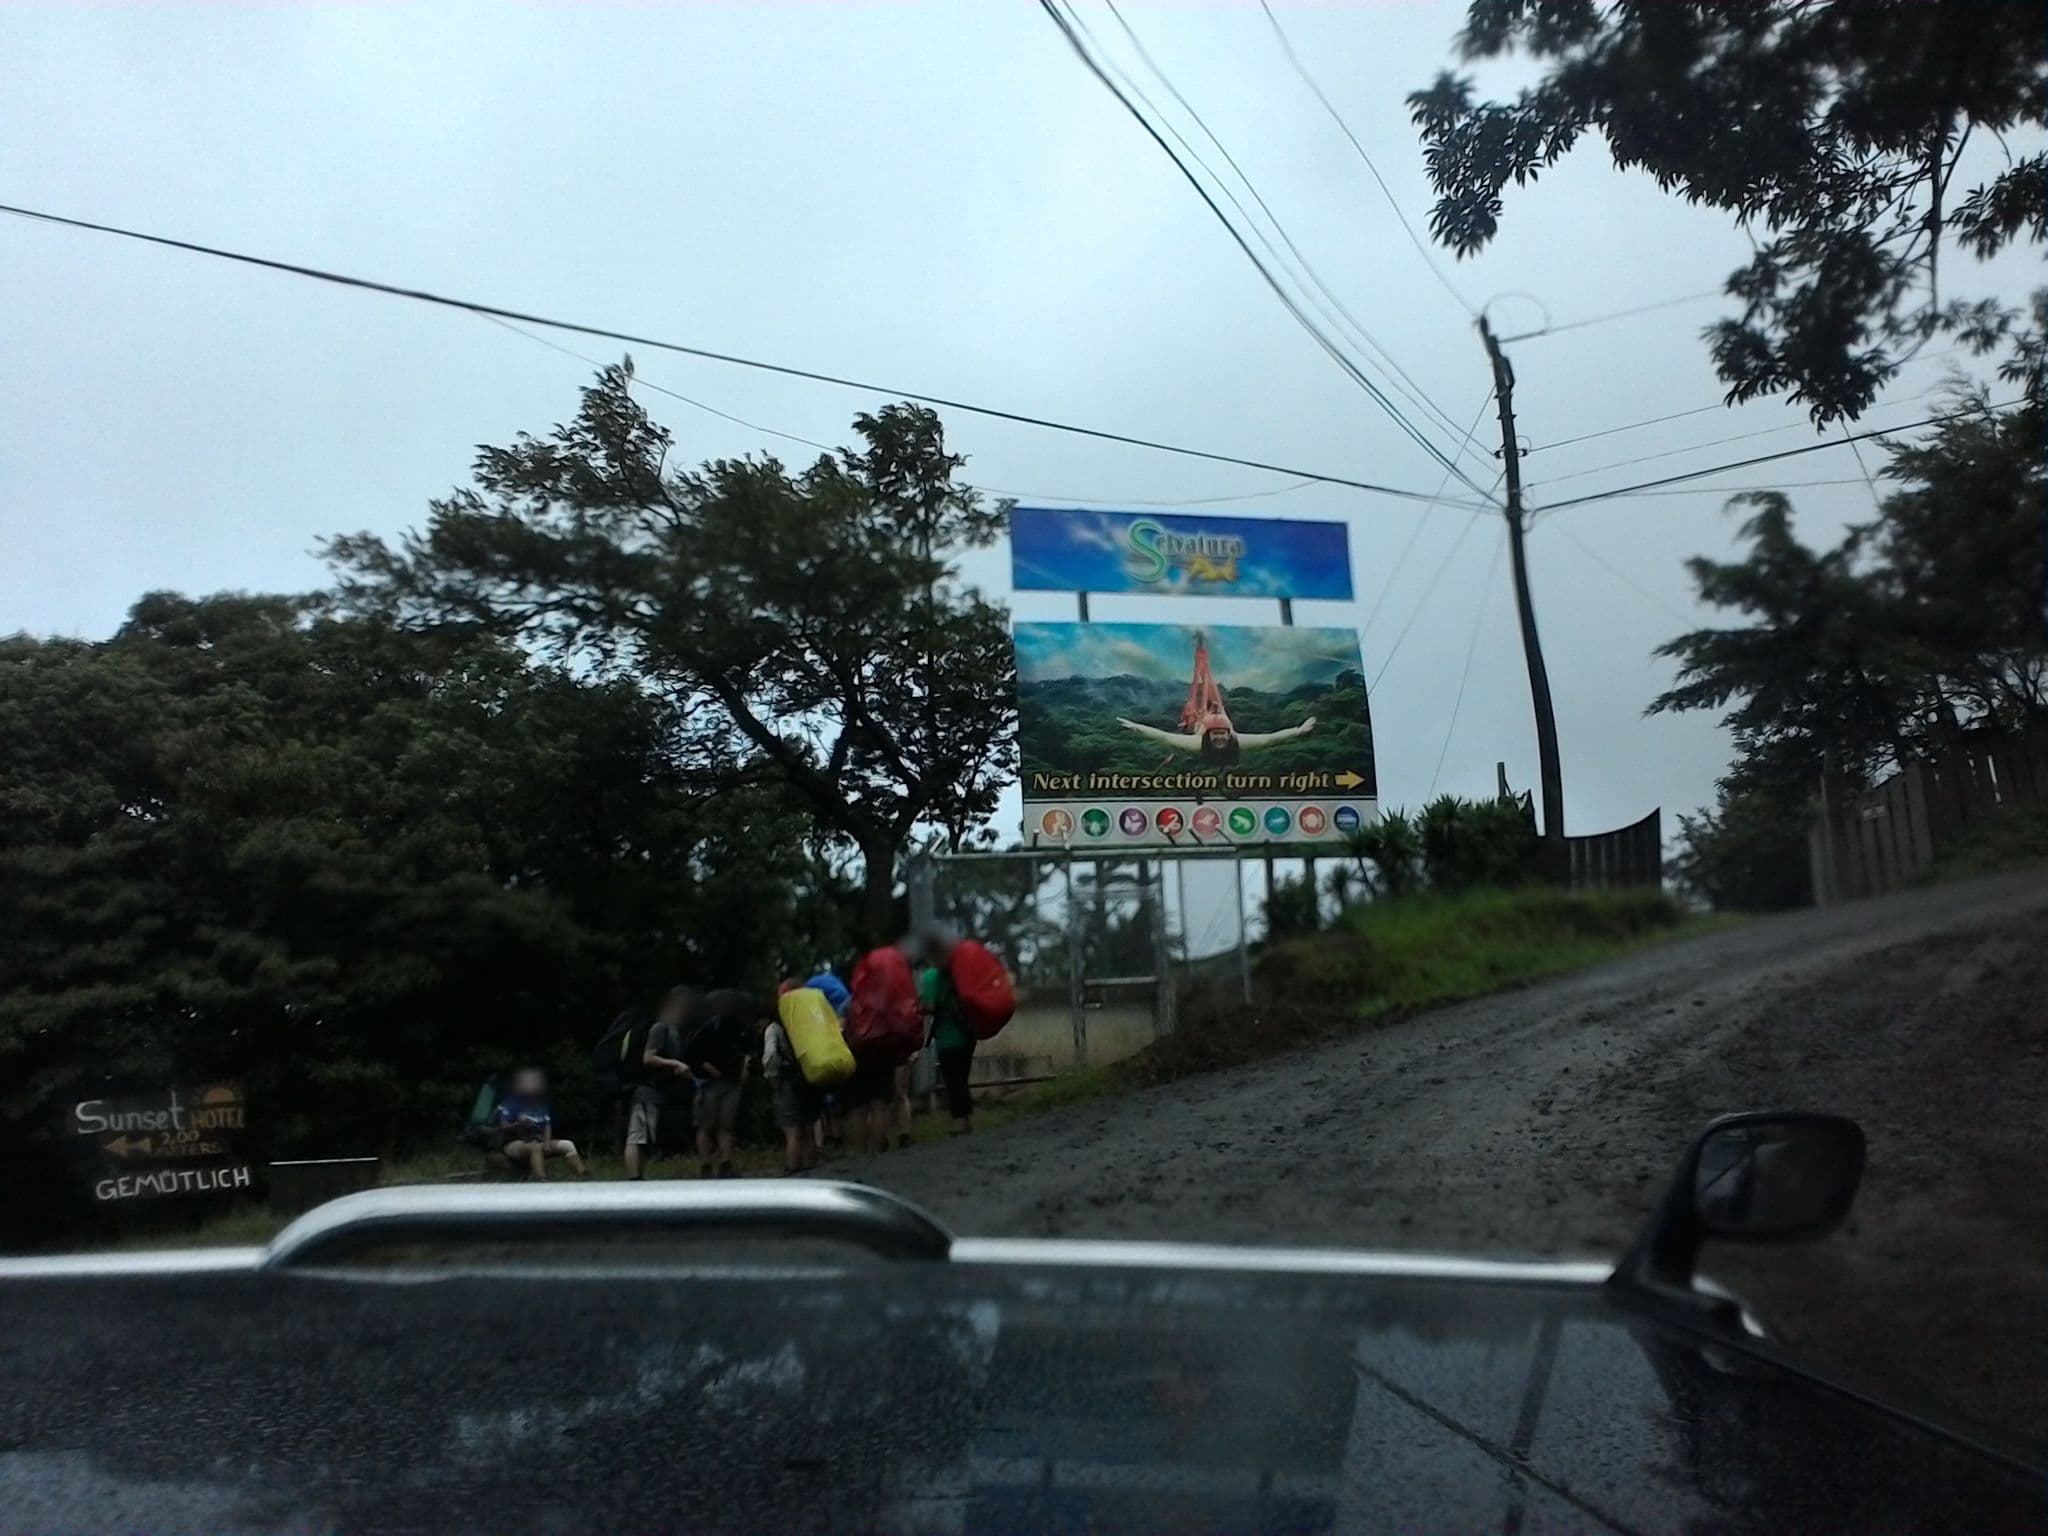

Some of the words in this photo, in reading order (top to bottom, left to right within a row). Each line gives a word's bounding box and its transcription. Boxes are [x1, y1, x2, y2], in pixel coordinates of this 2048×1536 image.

[1033, 773, 1081, 790] Next
[1089, 772, 1217, 790] intersection
[1226, 773, 1271, 789] turn
[1279, 771, 1330, 790] right
[75, 1089, 185, 1134] Sunset
